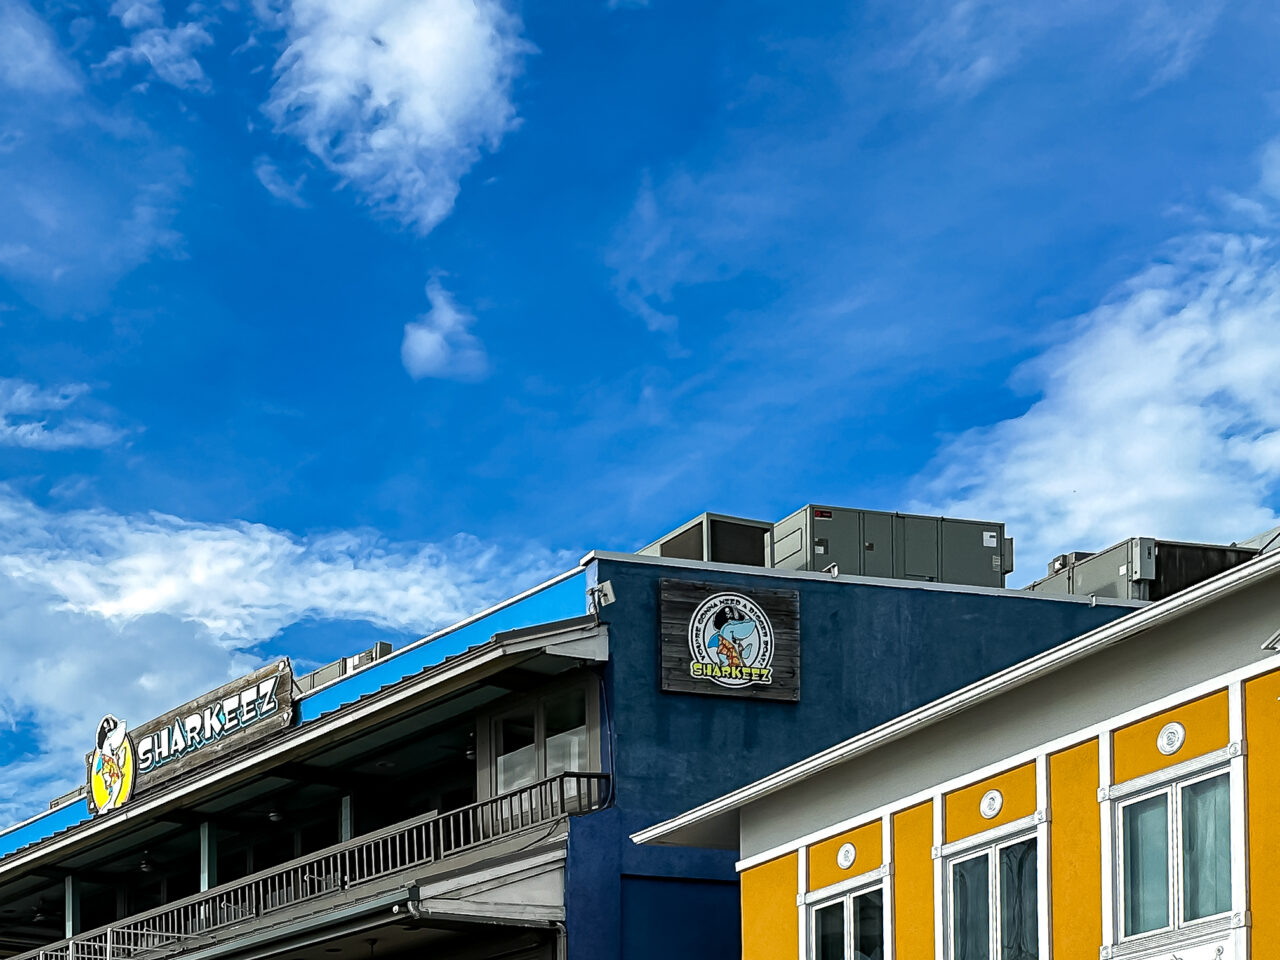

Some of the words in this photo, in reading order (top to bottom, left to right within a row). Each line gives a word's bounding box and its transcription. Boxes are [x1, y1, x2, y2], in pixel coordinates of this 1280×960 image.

[698, 602, 719, 625] GONNA
[748, 607, 768, 638] BIGGER
[693, 663, 770, 681] SHARKEEZ
[137, 674, 280, 773] SHARKEEZ
